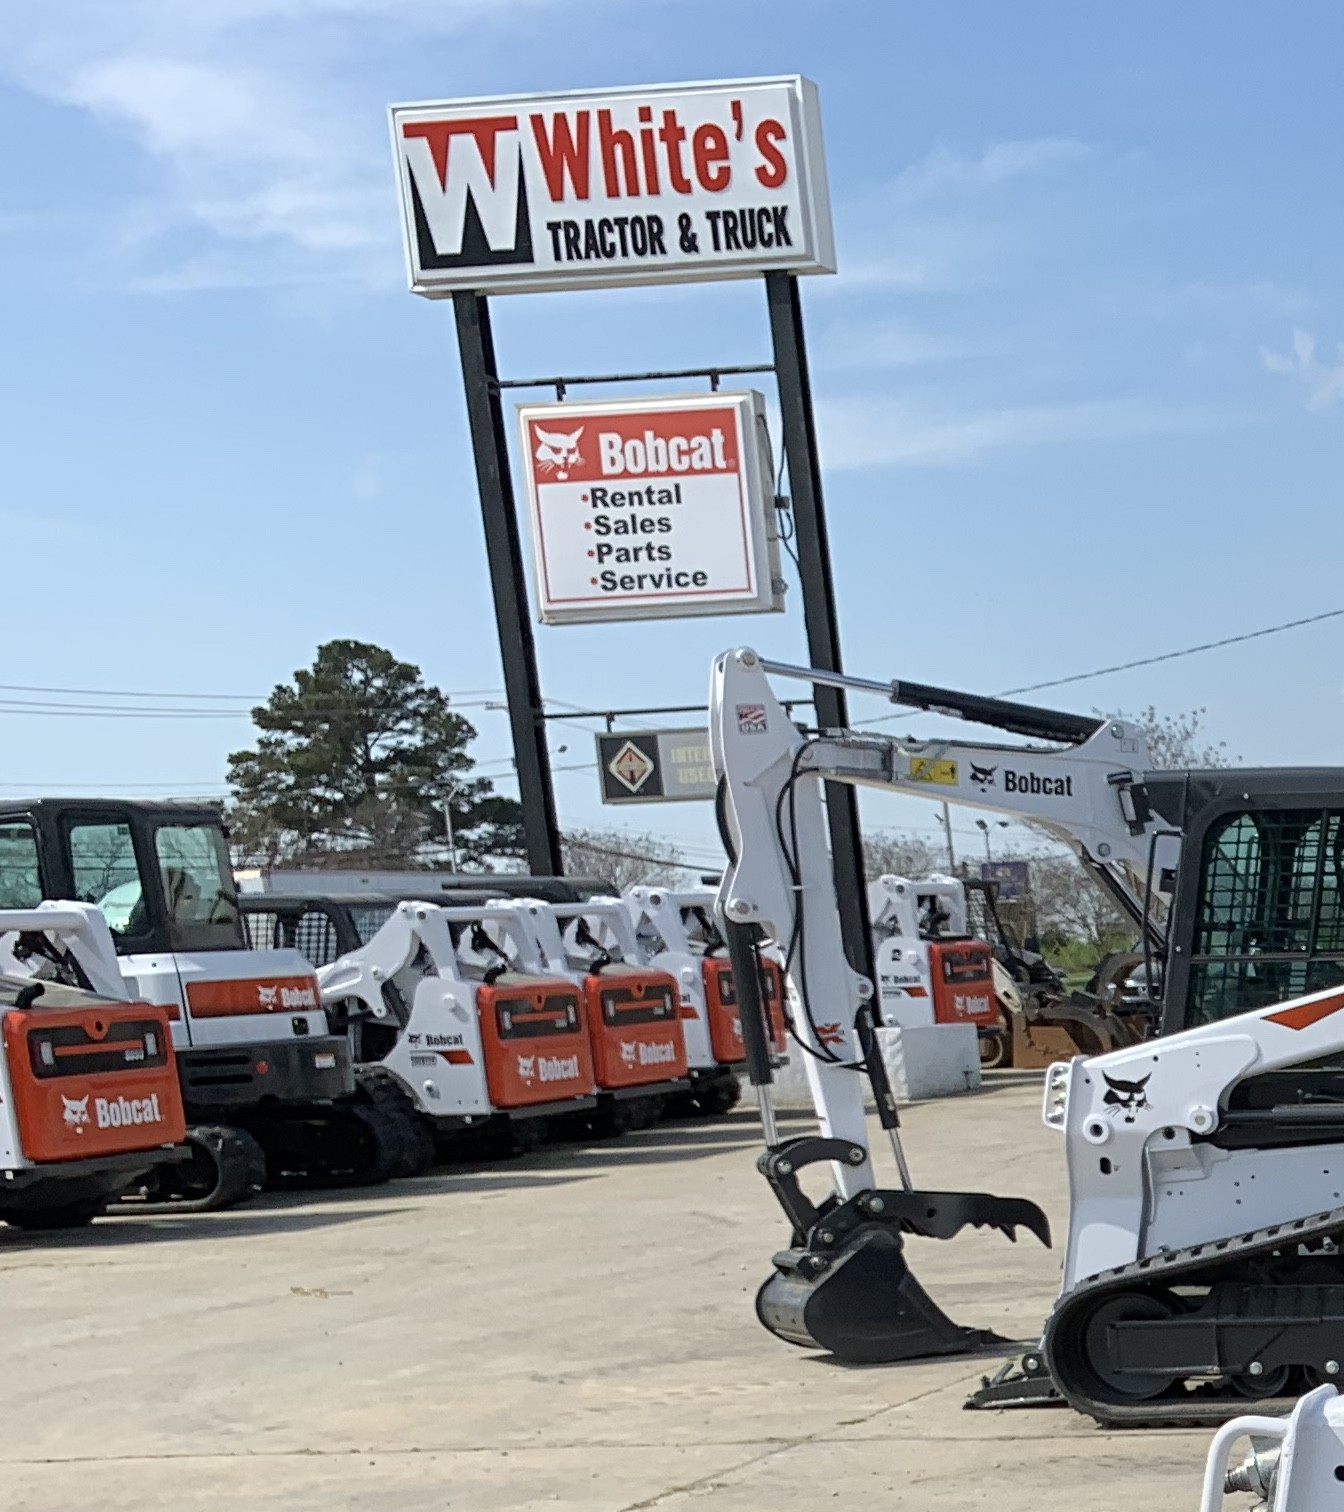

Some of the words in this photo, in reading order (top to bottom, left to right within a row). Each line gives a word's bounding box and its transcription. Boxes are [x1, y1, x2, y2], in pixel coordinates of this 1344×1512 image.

[529, 100, 788, 202] White's
[547, 214, 668, 262] TRACTOR
[678, 212, 700, 254] &
[705, 205, 793, 252] TRUCK
[598, 428, 728, 475] Bobcat
[589, 483, 682, 509] Rental
[594, 513, 672, 536] Sales
[595, 541, 672, 565] Parts
[599, 567, 708, 592] Service
[1003, 770, 1073, 798] Bobcat
[426, 1033, 464, 1047] Bobcat
[538, 1054, 580, 1083] Bobcat
[94, 1092, 162, 1130] Bobcat
